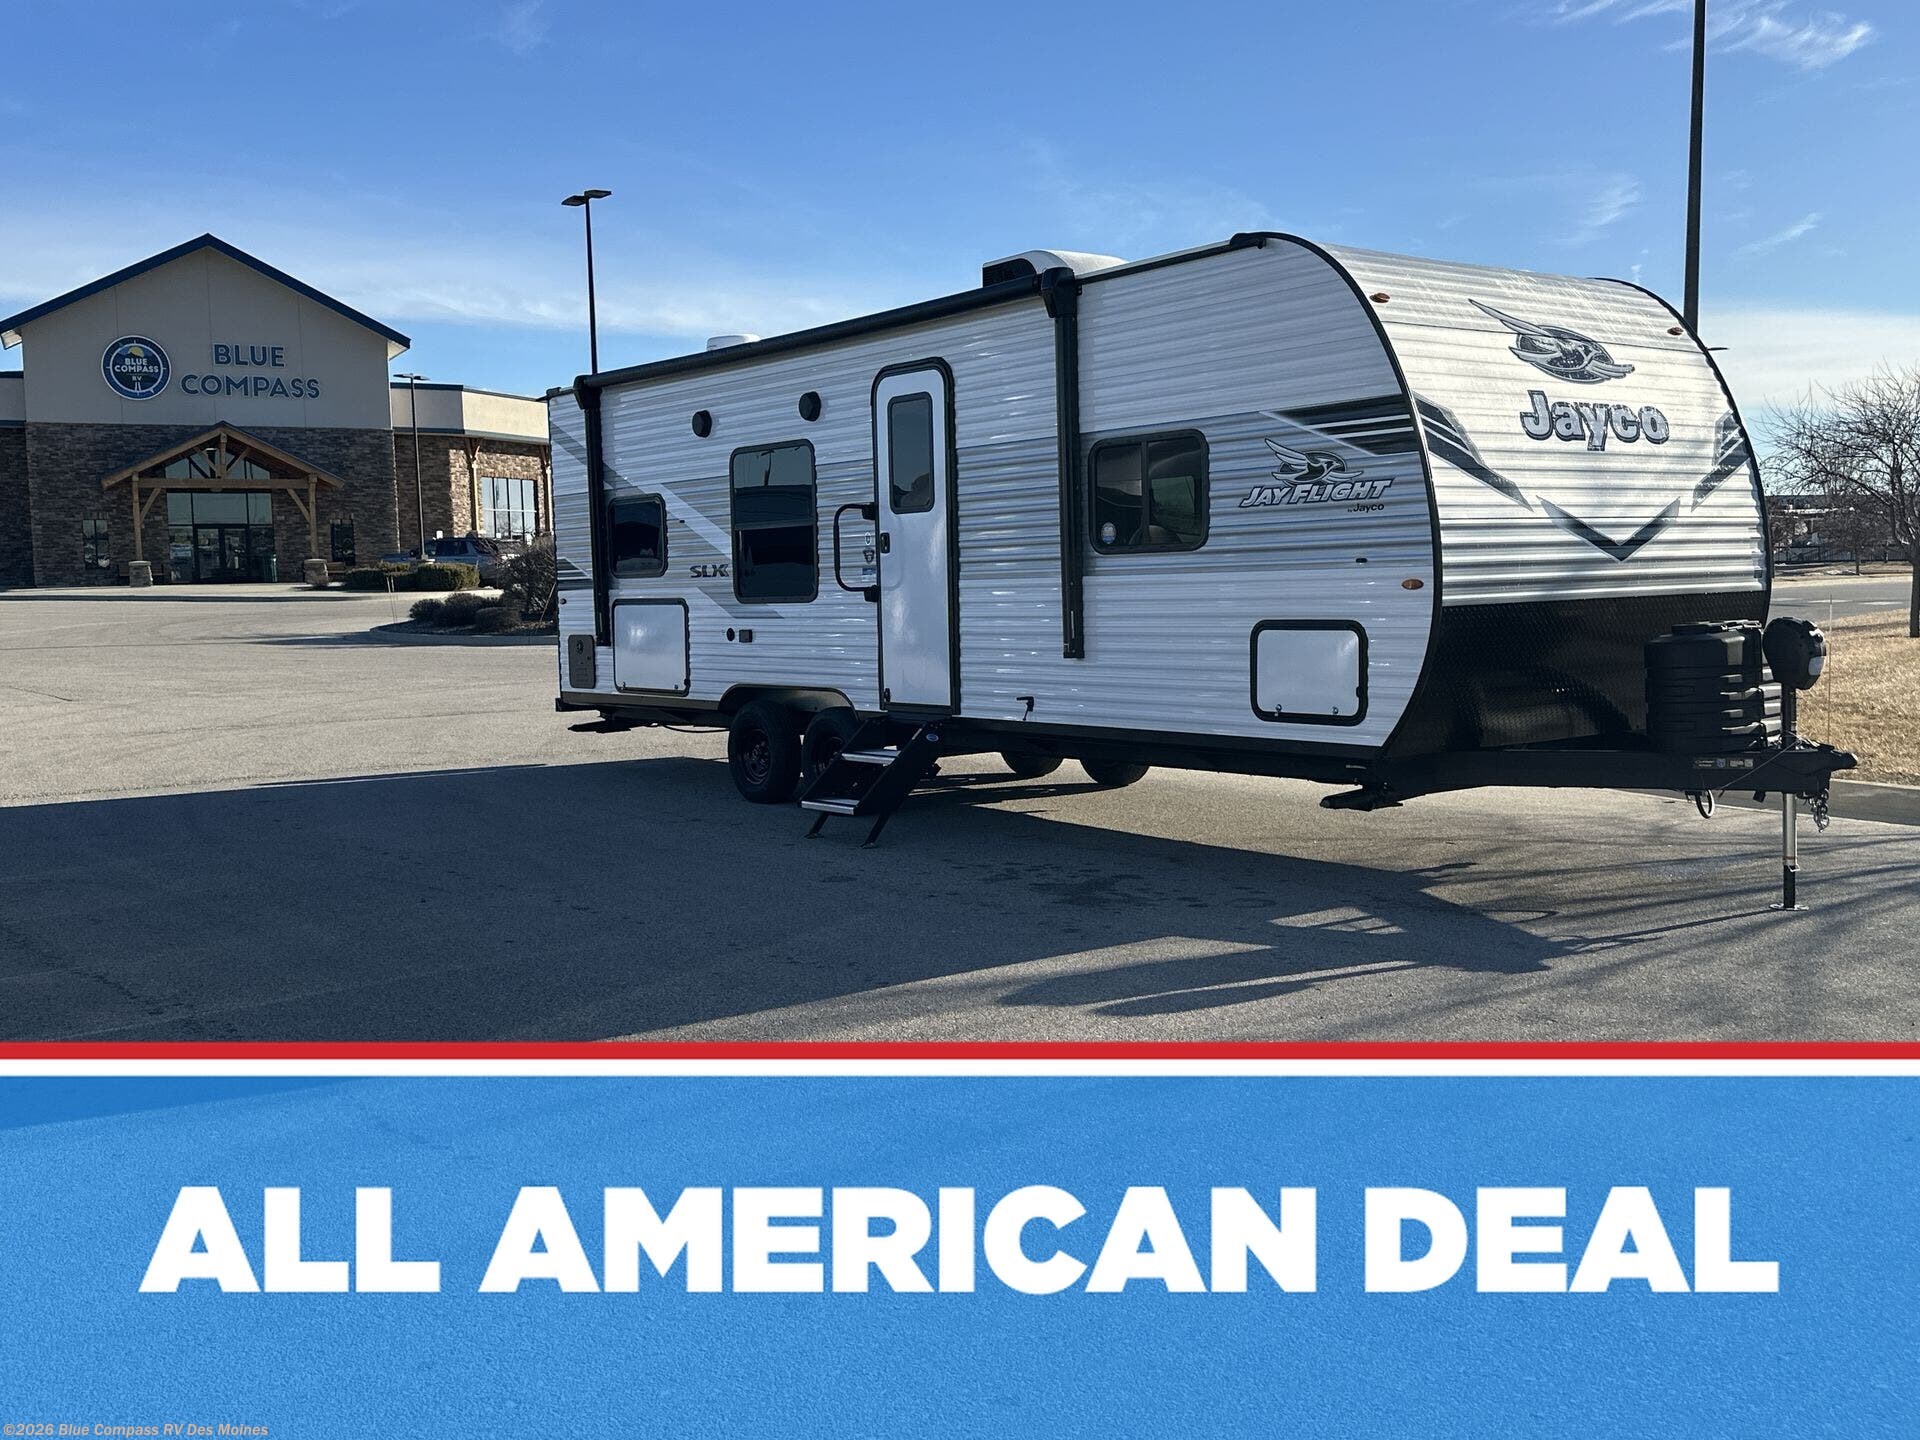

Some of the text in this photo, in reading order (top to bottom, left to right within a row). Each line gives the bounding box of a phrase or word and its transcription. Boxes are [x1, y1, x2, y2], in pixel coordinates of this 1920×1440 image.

[125, 357, 148, 366] BLUE
[214, 343, 286, 367] BLUE
[114, 365, 159, 373] COMPASS
[181, 373, 321, 399] COMPASS
[1520, 390, 1670, 451] Jayco
[1353, 503, 1385, 513] Jayco
